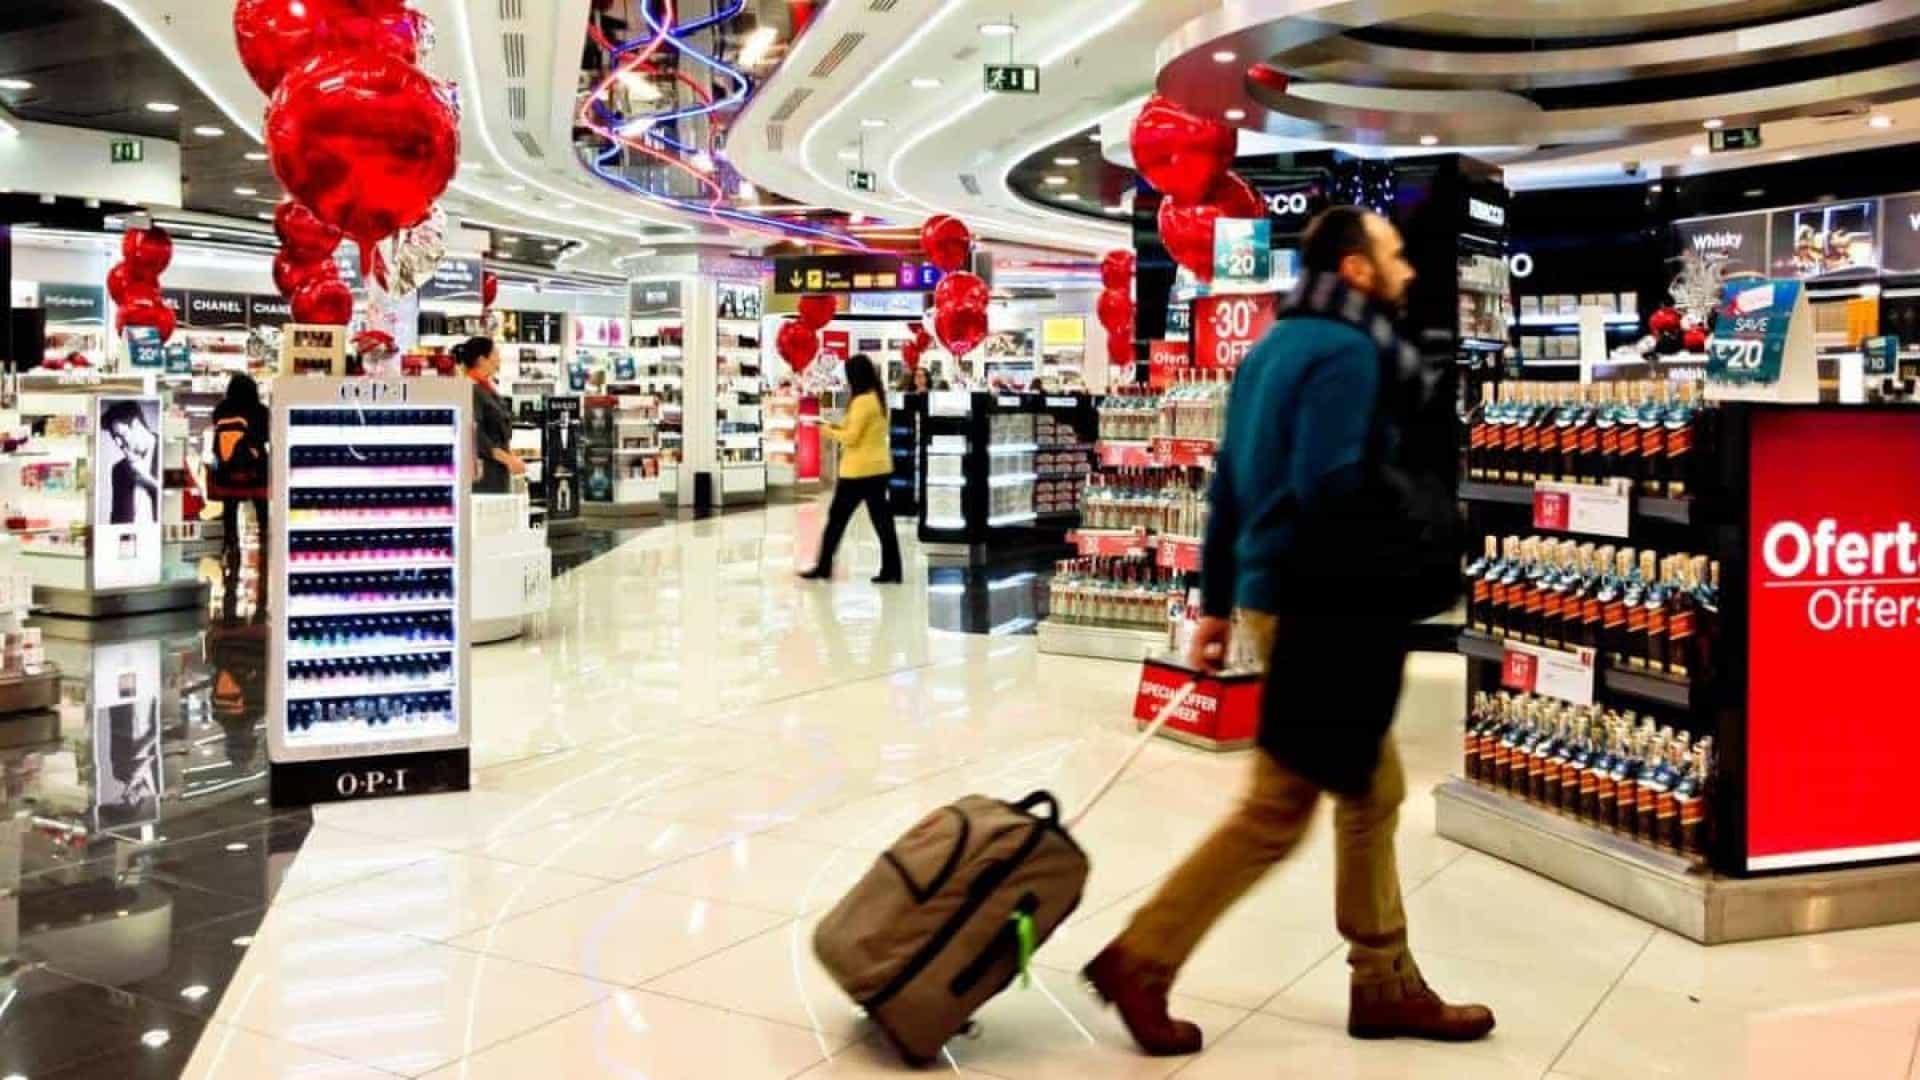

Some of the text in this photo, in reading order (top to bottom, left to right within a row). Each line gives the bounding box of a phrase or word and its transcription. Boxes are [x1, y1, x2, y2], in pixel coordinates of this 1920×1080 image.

[1692, 231, 1742, 250] Whisky
[193, 299, 243, 313] CHANEL
[253, 302, 291, 315] CHANE
[1735, 317, 1769, 333] SAVE
[1762, 517, 1920, 577] Ofert
